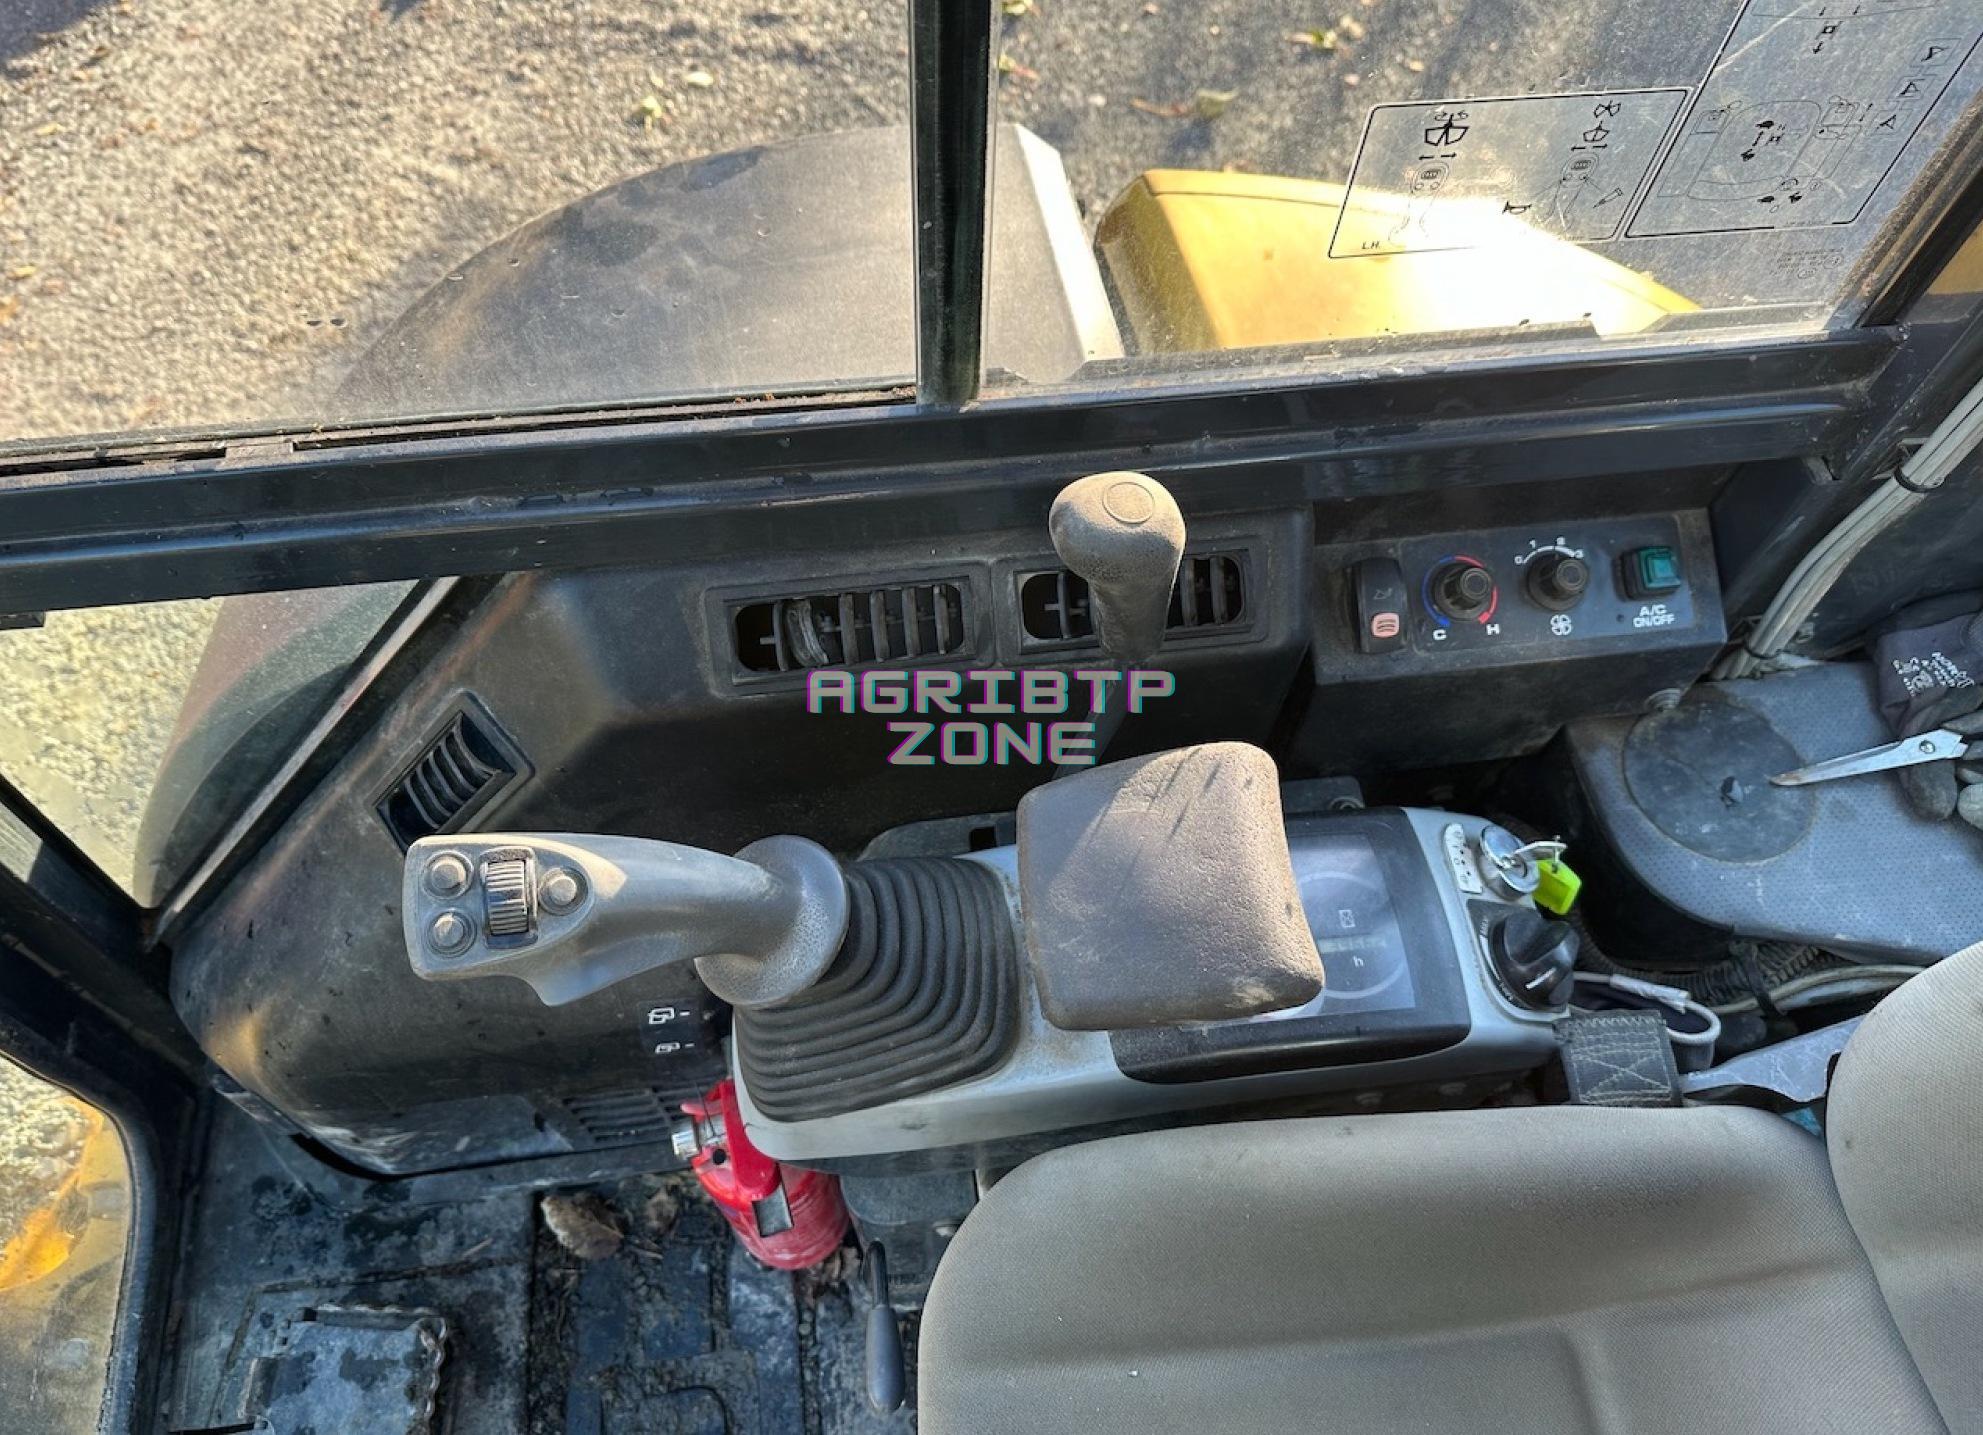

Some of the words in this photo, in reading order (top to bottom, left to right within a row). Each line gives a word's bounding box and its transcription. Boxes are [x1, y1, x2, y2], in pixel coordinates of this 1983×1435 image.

[1529, 540, 1536, 549] 1
[1640, 604, 1667, 616] A/C
[1633, 613, 1675, 628] ON/OFF
[1433, 629, 1447, 641] C
[1486, 623, 1500, 636] H
